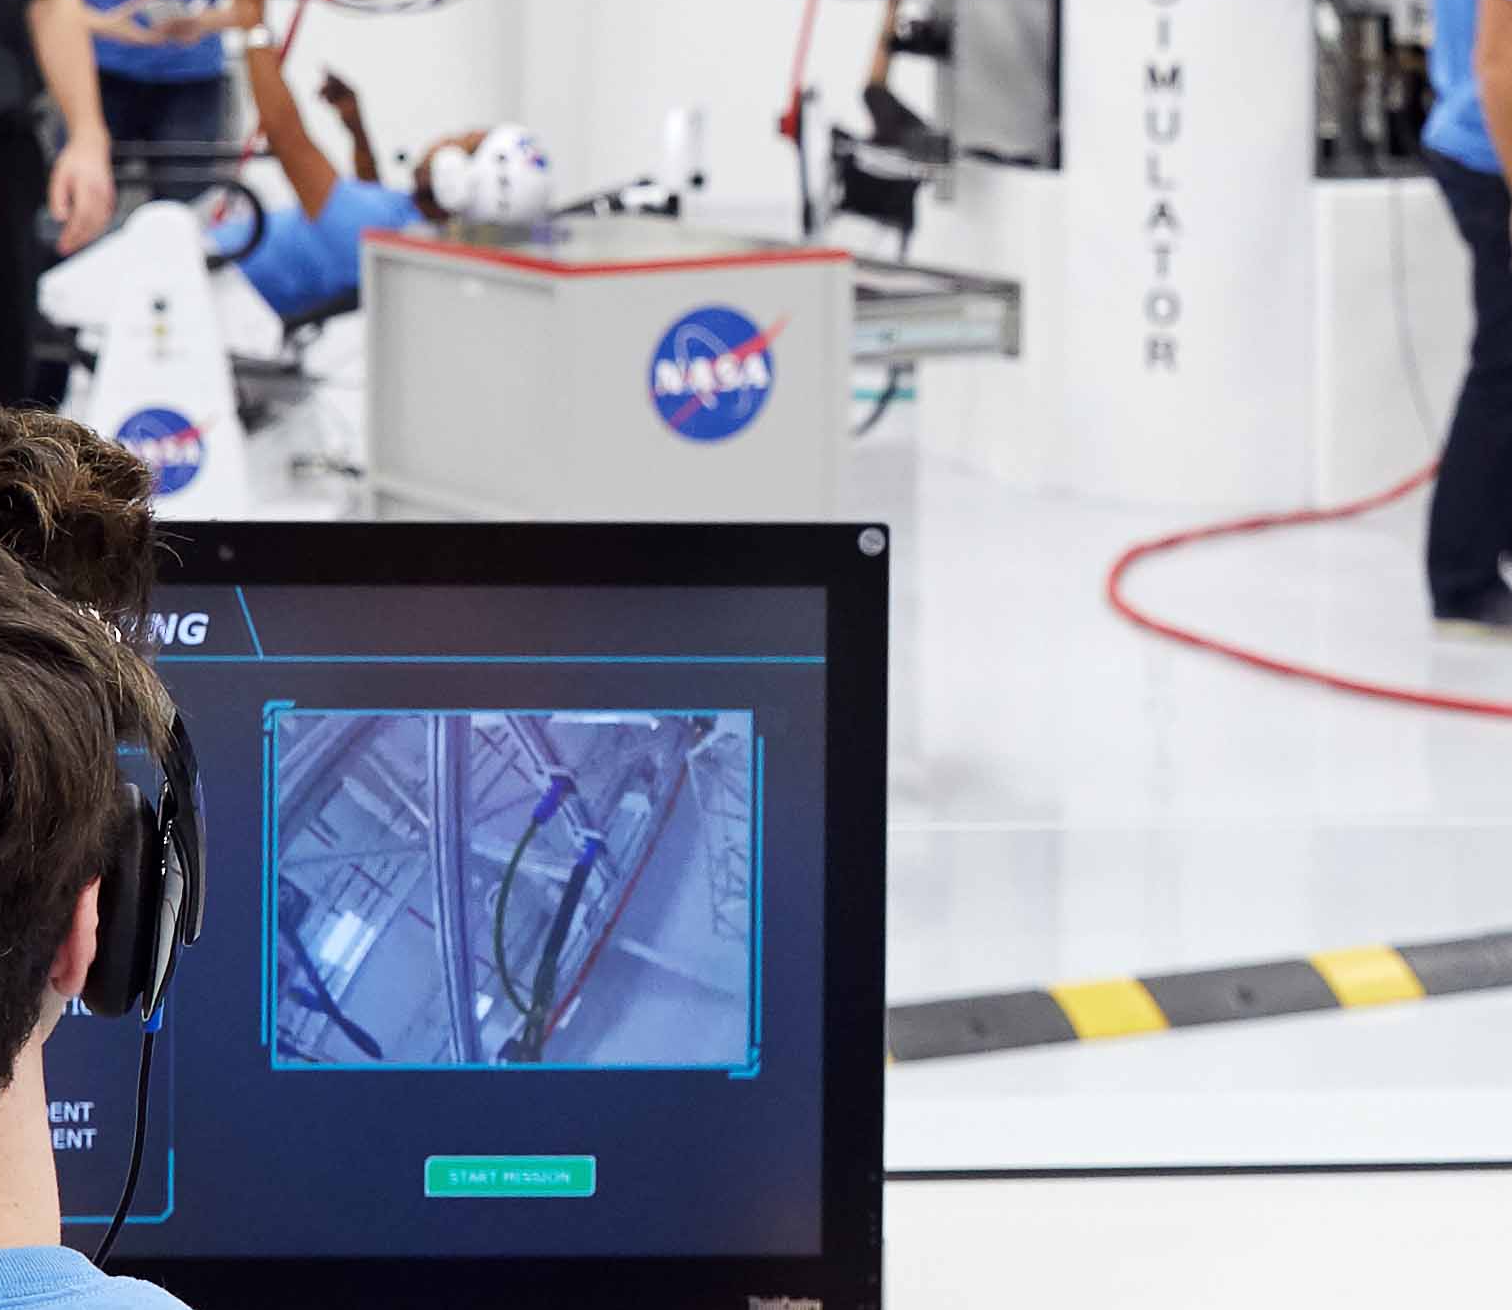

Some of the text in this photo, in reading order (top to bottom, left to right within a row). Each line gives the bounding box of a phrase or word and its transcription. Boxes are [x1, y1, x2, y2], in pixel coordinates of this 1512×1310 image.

[654, 352, 770, 395] NASA
[146, 611, 209, 645] NG
[47, 1101, 95, 1122] ENT
[52, 1128, 97, 1149] ENT
